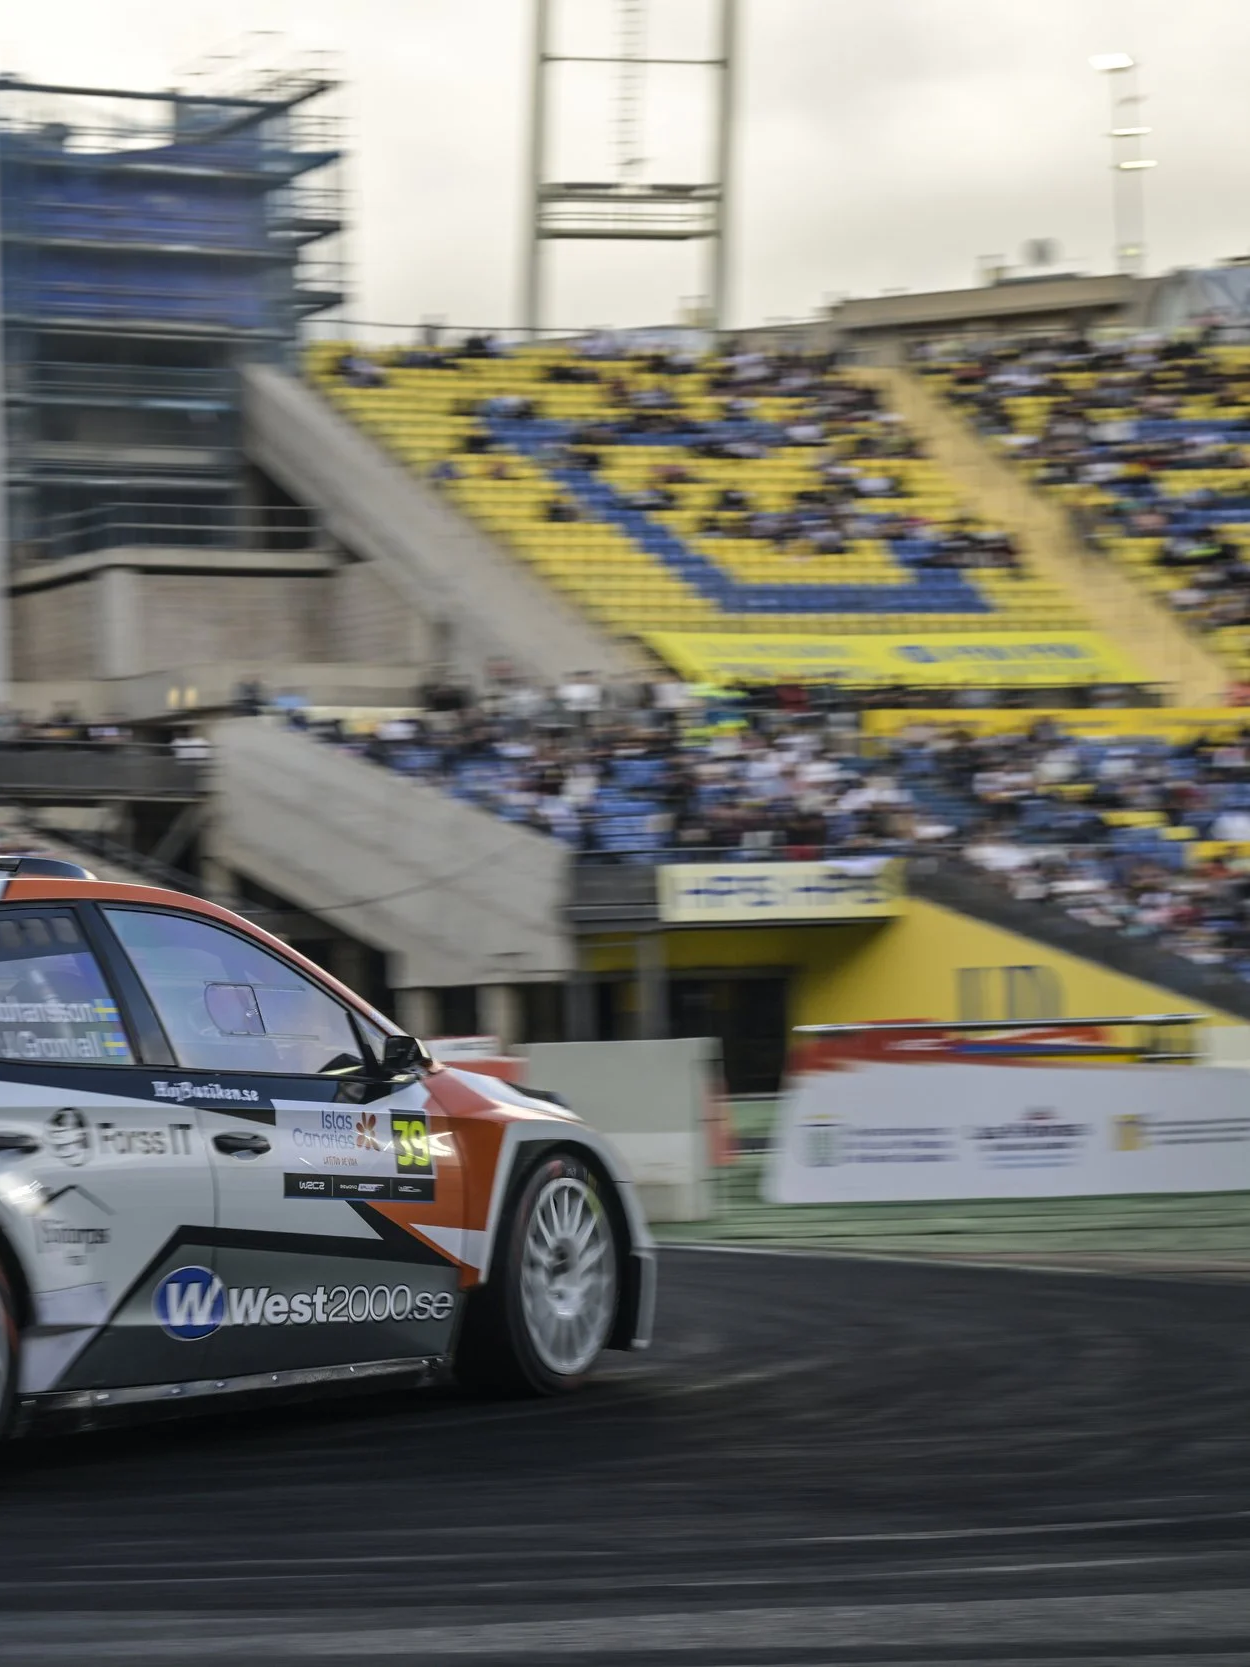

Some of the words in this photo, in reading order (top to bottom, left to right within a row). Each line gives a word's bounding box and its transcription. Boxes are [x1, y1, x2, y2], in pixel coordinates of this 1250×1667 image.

[321, 1110, 353, 1130] Islas
[292, 1127, 355, 1149] Canarias
[392, 1120, 431, 1167] 39
[228, 1284, 454, 1326] West2000.se
